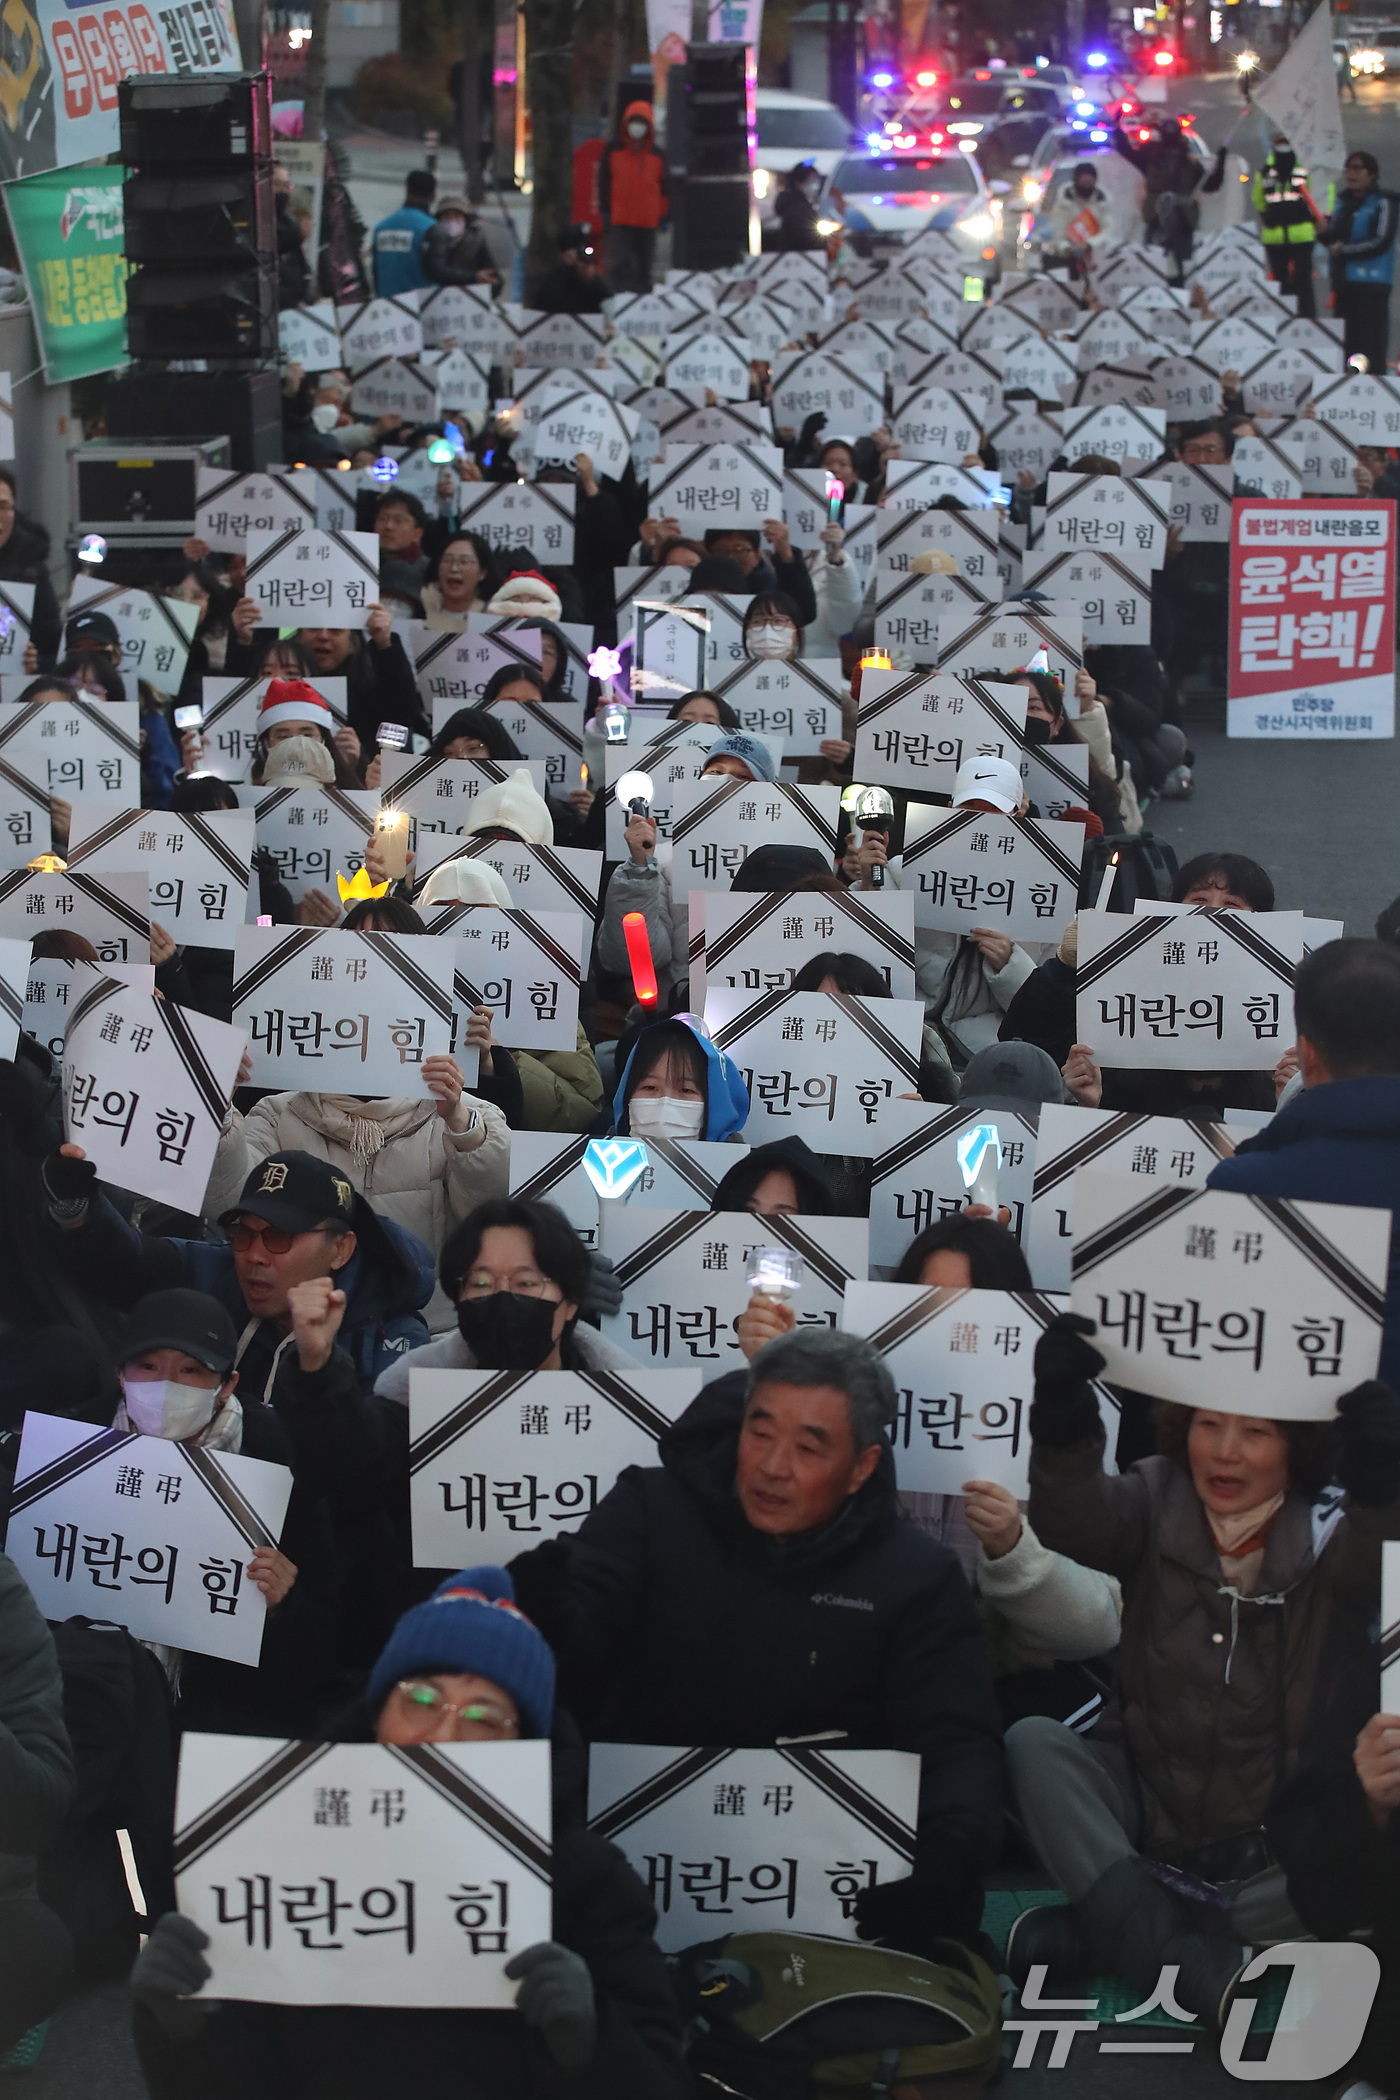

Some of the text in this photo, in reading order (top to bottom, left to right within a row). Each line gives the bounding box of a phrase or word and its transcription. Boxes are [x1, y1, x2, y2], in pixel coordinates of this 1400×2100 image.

[549, 424, 604, 450] 내란의
[676, 486, 769, 512] 내란의 힘
[1057, 517, 1155, 550] 내란의 힘
[1245, 518, 1380, 537] 불법계엄 내란음모
[964, 555, 985, 577] 힘
[1240, 549, 1387, 605] 윤석열
[258, 578, 368, 609] 내란의 힘
[1115, 599, 1137, 626] 힘
[1239, 603, 1385, 673] 탄핵!
[922, 693, 964, 716] 謹弔
[1292, 697, 1334, 712] 민주당
[803, 707, 828, 736] 힘
[1255, 714, 1373, 732] 경산시지역위원회
[872, 729, 964, 773] 내란의
[96, 758, 122, 791] 힘
[437, 778, 480, 799] 謹弔
[289, 807, 329, 827] 謹弔
[739, 801, 782, 822] 謹弔
[4, 811, 33, 846] 힘
[971, 832, 1016, 856] 謹弔
[26, 894, 75, 915] 謹弔
[197, 883, 228, 921] 힘
[918, 869, 1060, 918] 내란의 힘
[783, 916, 836, 940] 謹弔
[311, 956, 368, 982] 謹弔
[1163, 940, 1220, 966] 謹弔
[527, 981, 559, 1021] 힘
[1097, 992, 1281, 1041] 내란의 힘
[99, 1012, 154, 1053] 謹弔
[250, 1009, 426, 1063] 내란의 힘
[781, 1016, 837, 1043] 謹弔
[155, 1107, 196, 1166] 힘
[257, 1161, 290, 1193] D
[1132, 1145, 1196, 1179] 謹弔
[1186, 1224, 1264, 1265] 謹弔
[950, 1321, 1022, 1357] 謹弔
[1096, 1289, 1346, 1378] 내란의 힘
[520, 1403, 593, 1436] 謹弔
[115, 1465, 182, 1505] 謹弔
[438, 1473, 598, 1532] 내란의
[33, 1522, 244, 1616] 내란의 힘
[823, 1593, 875, 1612] Columbia
[313, 1786, 407, 1829] 謹弔
[712, 1783, 796, 1817] 謹弔
[209, 1873, 509, 1956] 내란의 힘
